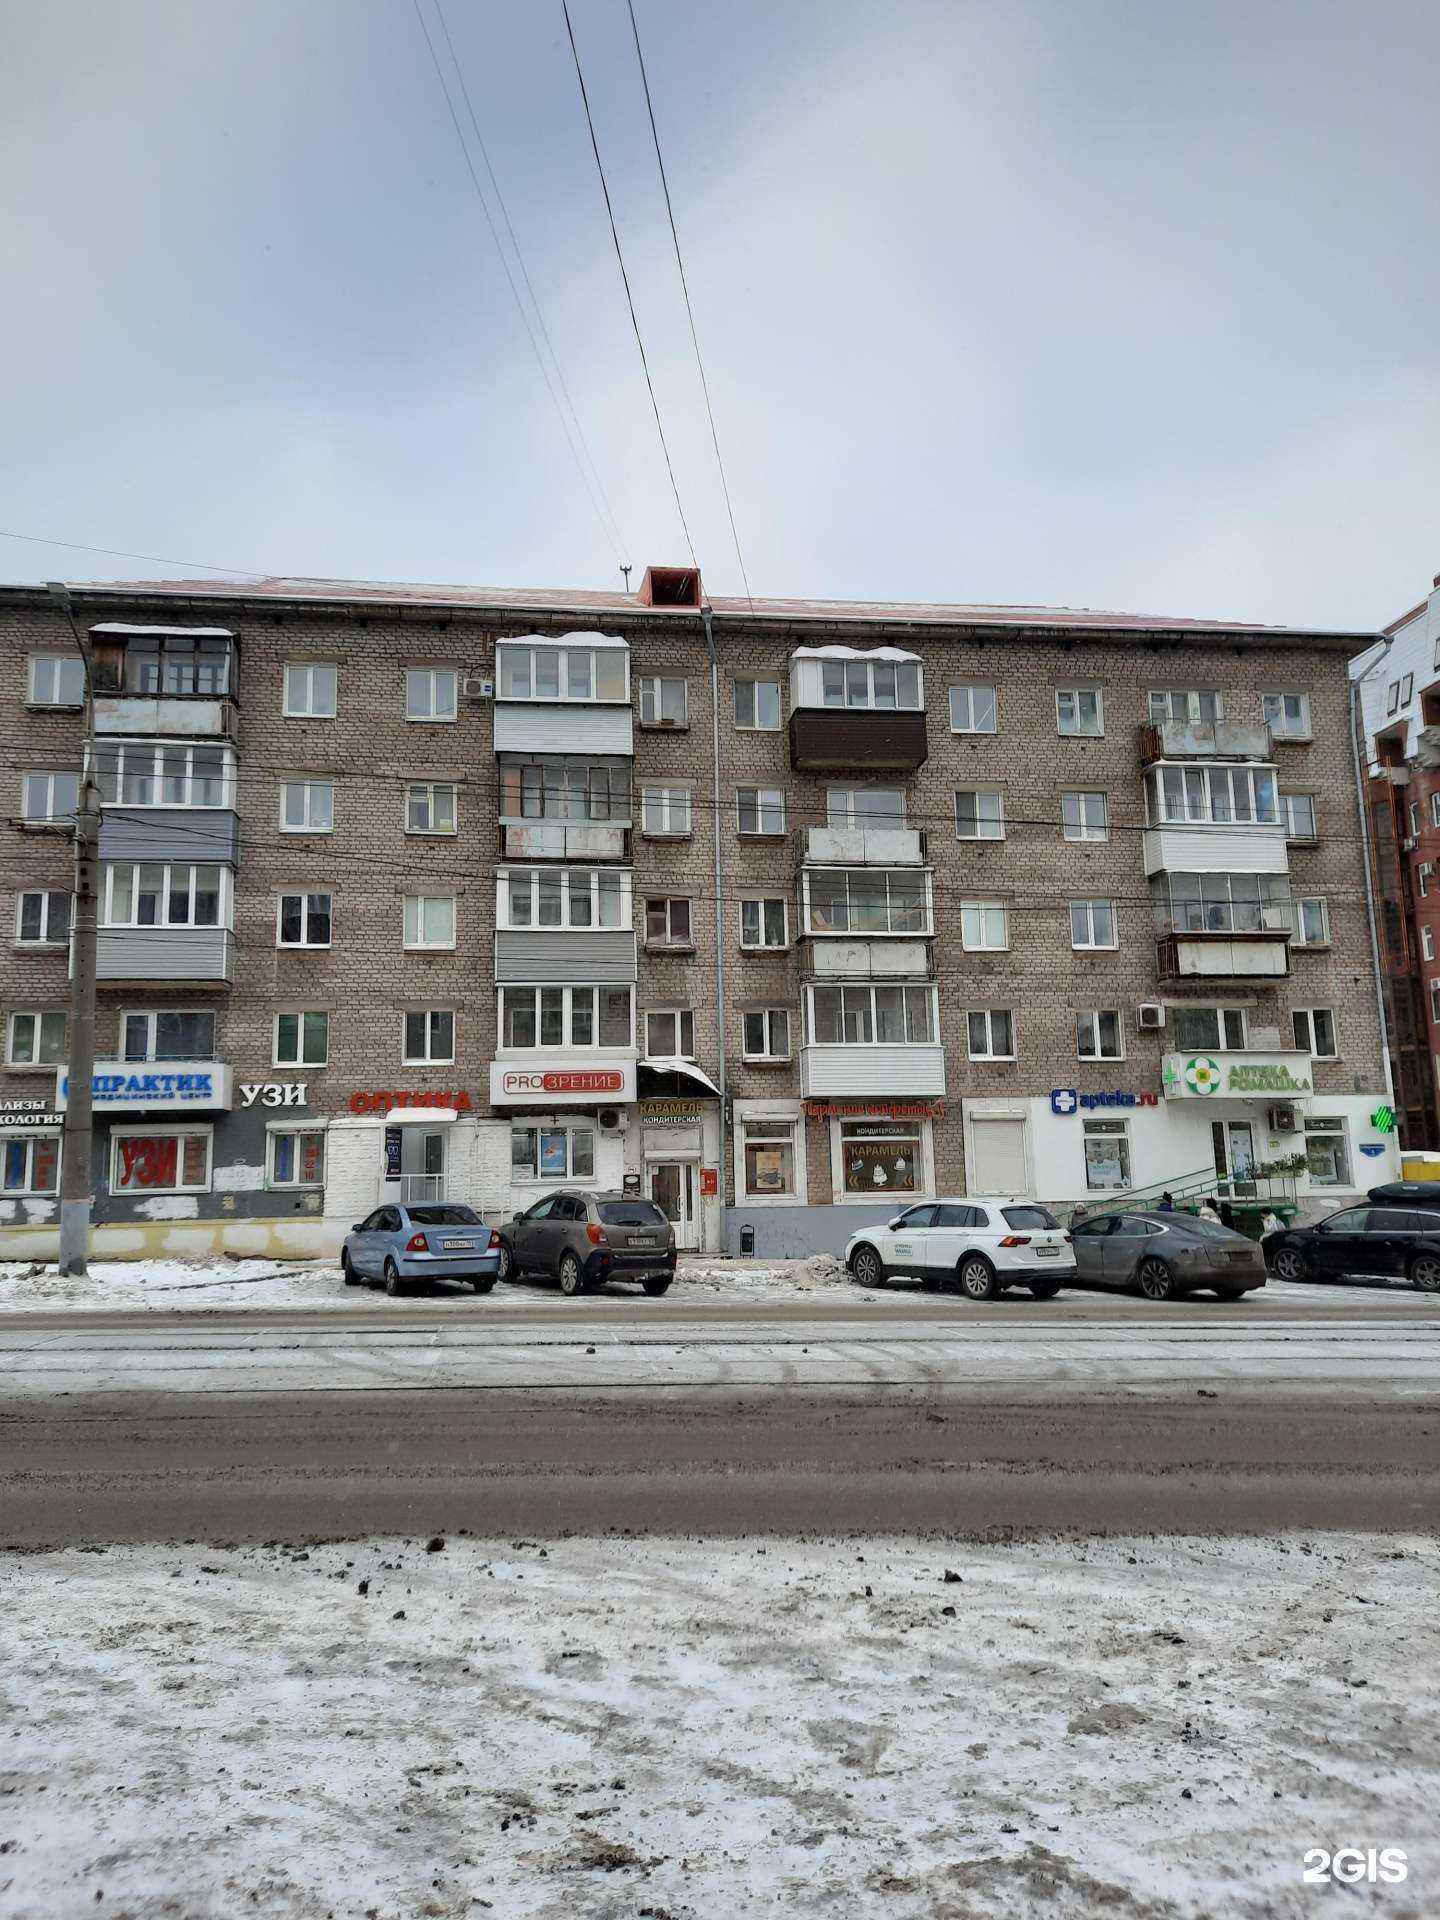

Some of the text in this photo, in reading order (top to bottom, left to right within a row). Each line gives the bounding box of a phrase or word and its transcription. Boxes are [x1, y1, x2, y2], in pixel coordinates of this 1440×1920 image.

[506, 1074, 618, 1090] PROЗРЕНИЕ
[239, 1084, 308, 1107] УЗИ
[350, 1090, 472, 1114] ОПТИКА
[639, 1103, 704, 1114] КАРАМЕЛЬ
[643, 1114, 701, 1124] КОНДИТЕРСКАЯ
[851, 1144, 911, 1157] КАРАМЕЛЬ
